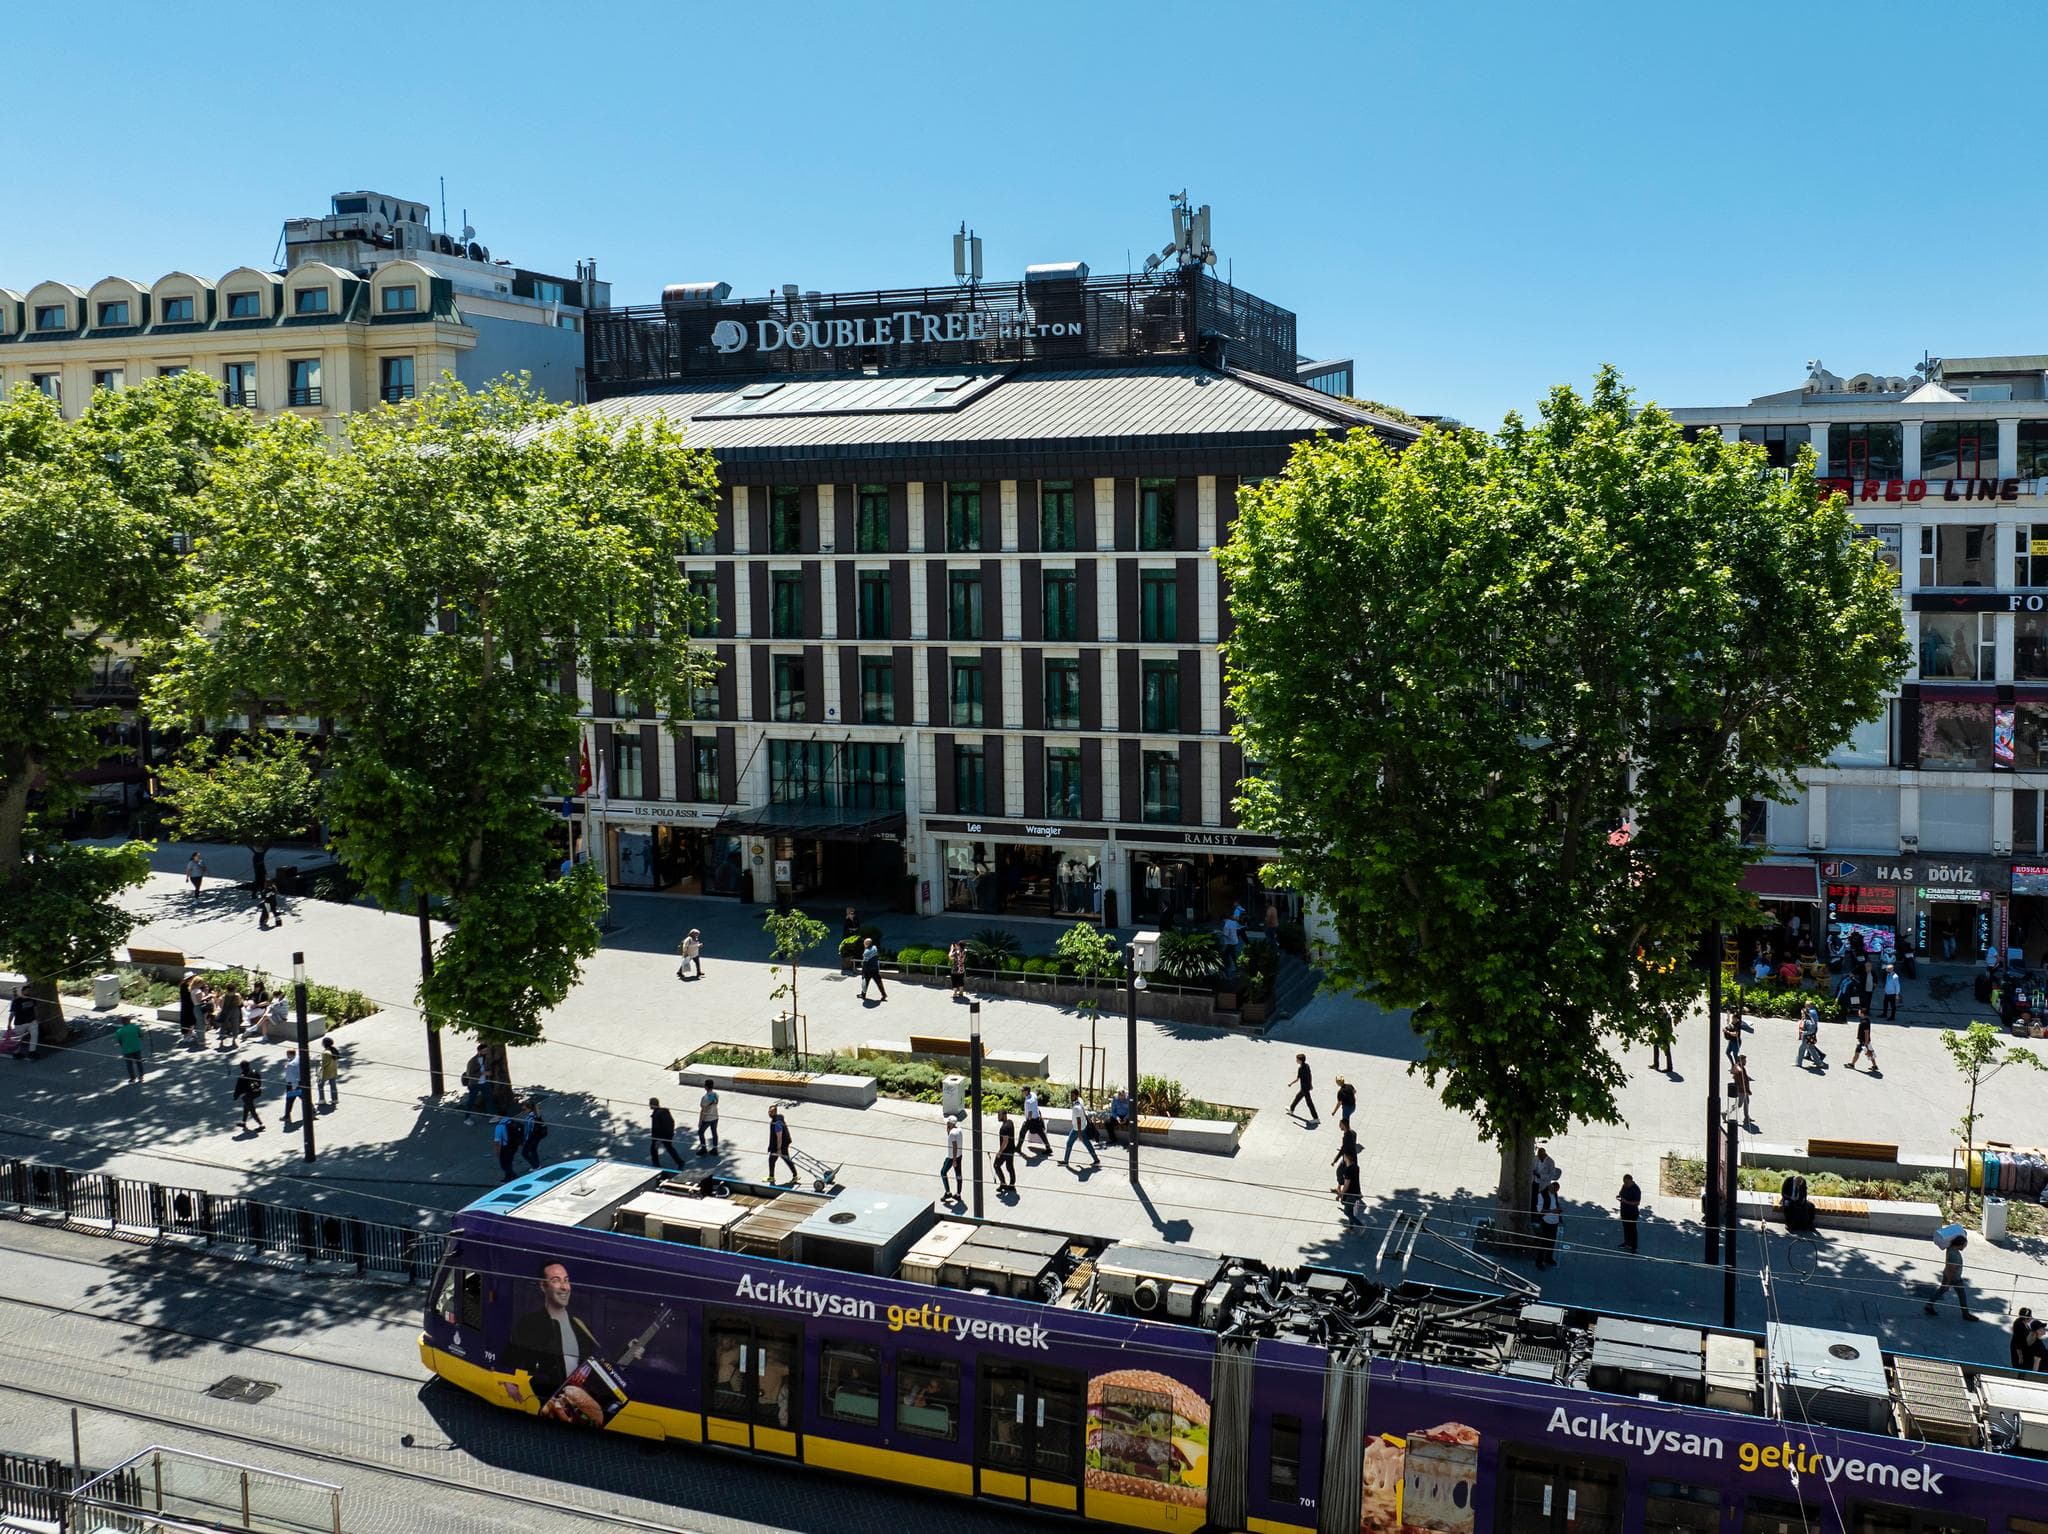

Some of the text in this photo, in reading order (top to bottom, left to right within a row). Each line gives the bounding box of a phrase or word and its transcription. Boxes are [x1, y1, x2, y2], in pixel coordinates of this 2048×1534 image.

[999, 322, 1082, 339] HILTON
[1861, 480, 1927, 502] RED
[1944, 478, 2020, 501] LINE
[2008, 595, 2048, 611] FO
[635, 807, 650, 816] U.S.
[652, 808, 673, 817] POLO
[966, 822, 1062, 838] Lee Wrangler
[1184, 833, 1238, 845] RAMSEY
[1877, 865, 1973, 883] HAS DÖVİZ
[735, 1273, 875, 1320] Acıktıysan
[485, 1351, 496, 1361] 701
[1546, 1406, 1723, 1459] Acıktıysan
[1300, 1498, 1315, 1508] 701
